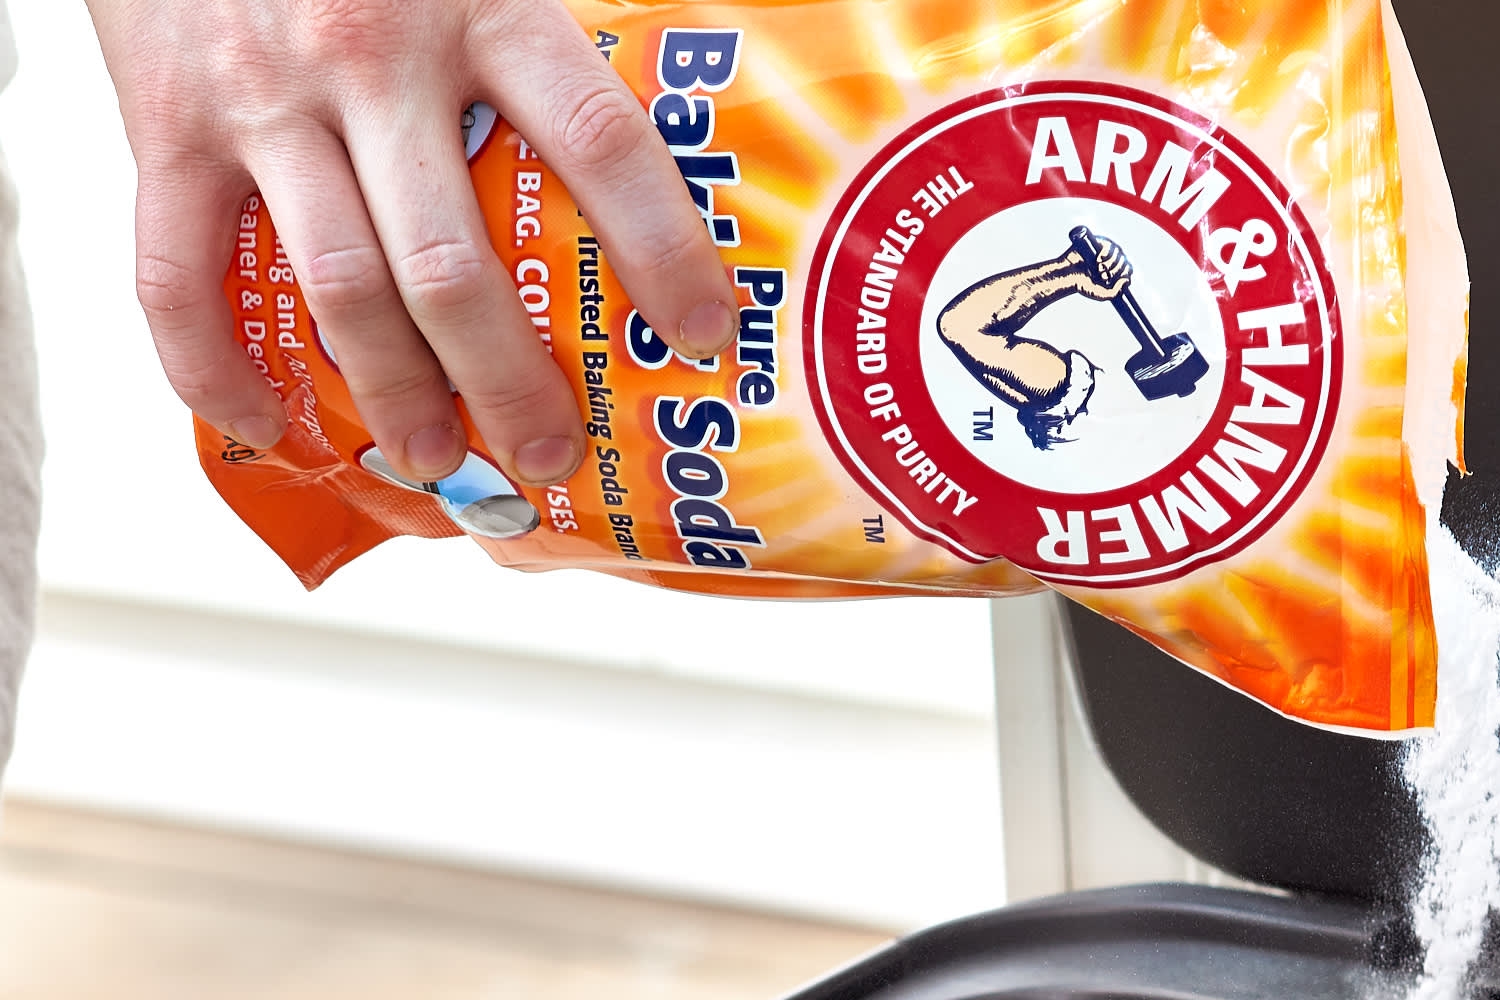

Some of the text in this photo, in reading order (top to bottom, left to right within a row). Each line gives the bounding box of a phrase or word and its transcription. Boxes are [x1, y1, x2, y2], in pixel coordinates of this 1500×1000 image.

[239, 196, 260, 282] eaner
[515, 171, 542, 248] BAG.
[241, 289, 264, 311] &
[276, 293, 305, 350] and
[734, 266, 787, 408] Pure
[855, 165, 979, 518] THE STANDARD OF PURITY
[1024, 116, 1311, 565] ARM & HAMMER
[582, 352, 615, 441] Baking
[972, 405, 994, 441] TM
[596, 445, 629, 507] Soda
[653, 395, 767, 570] Soda
[606, 512, 652, 562] Brand
[862, 513, 885, 544] TM
